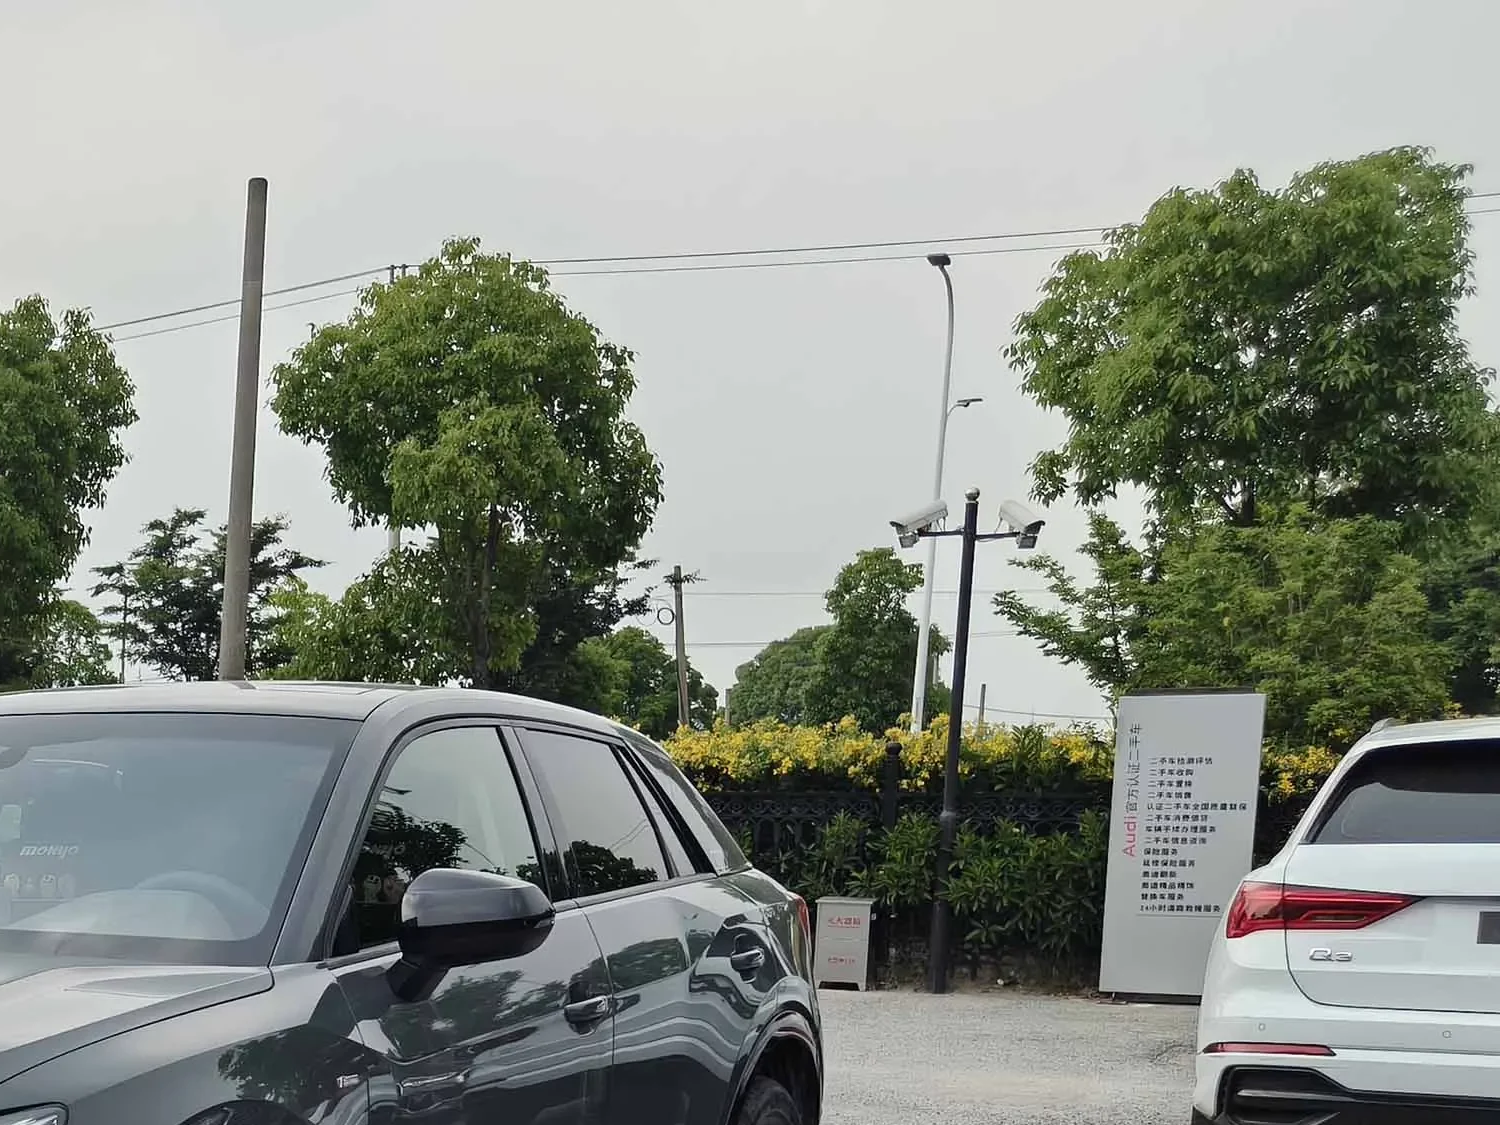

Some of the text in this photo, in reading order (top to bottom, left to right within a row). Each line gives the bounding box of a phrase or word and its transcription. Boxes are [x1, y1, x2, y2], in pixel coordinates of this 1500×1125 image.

[1121, 723, 1142, 857] Audi 官方认证二手车
[1309, 947, 1353, 962] Q3
